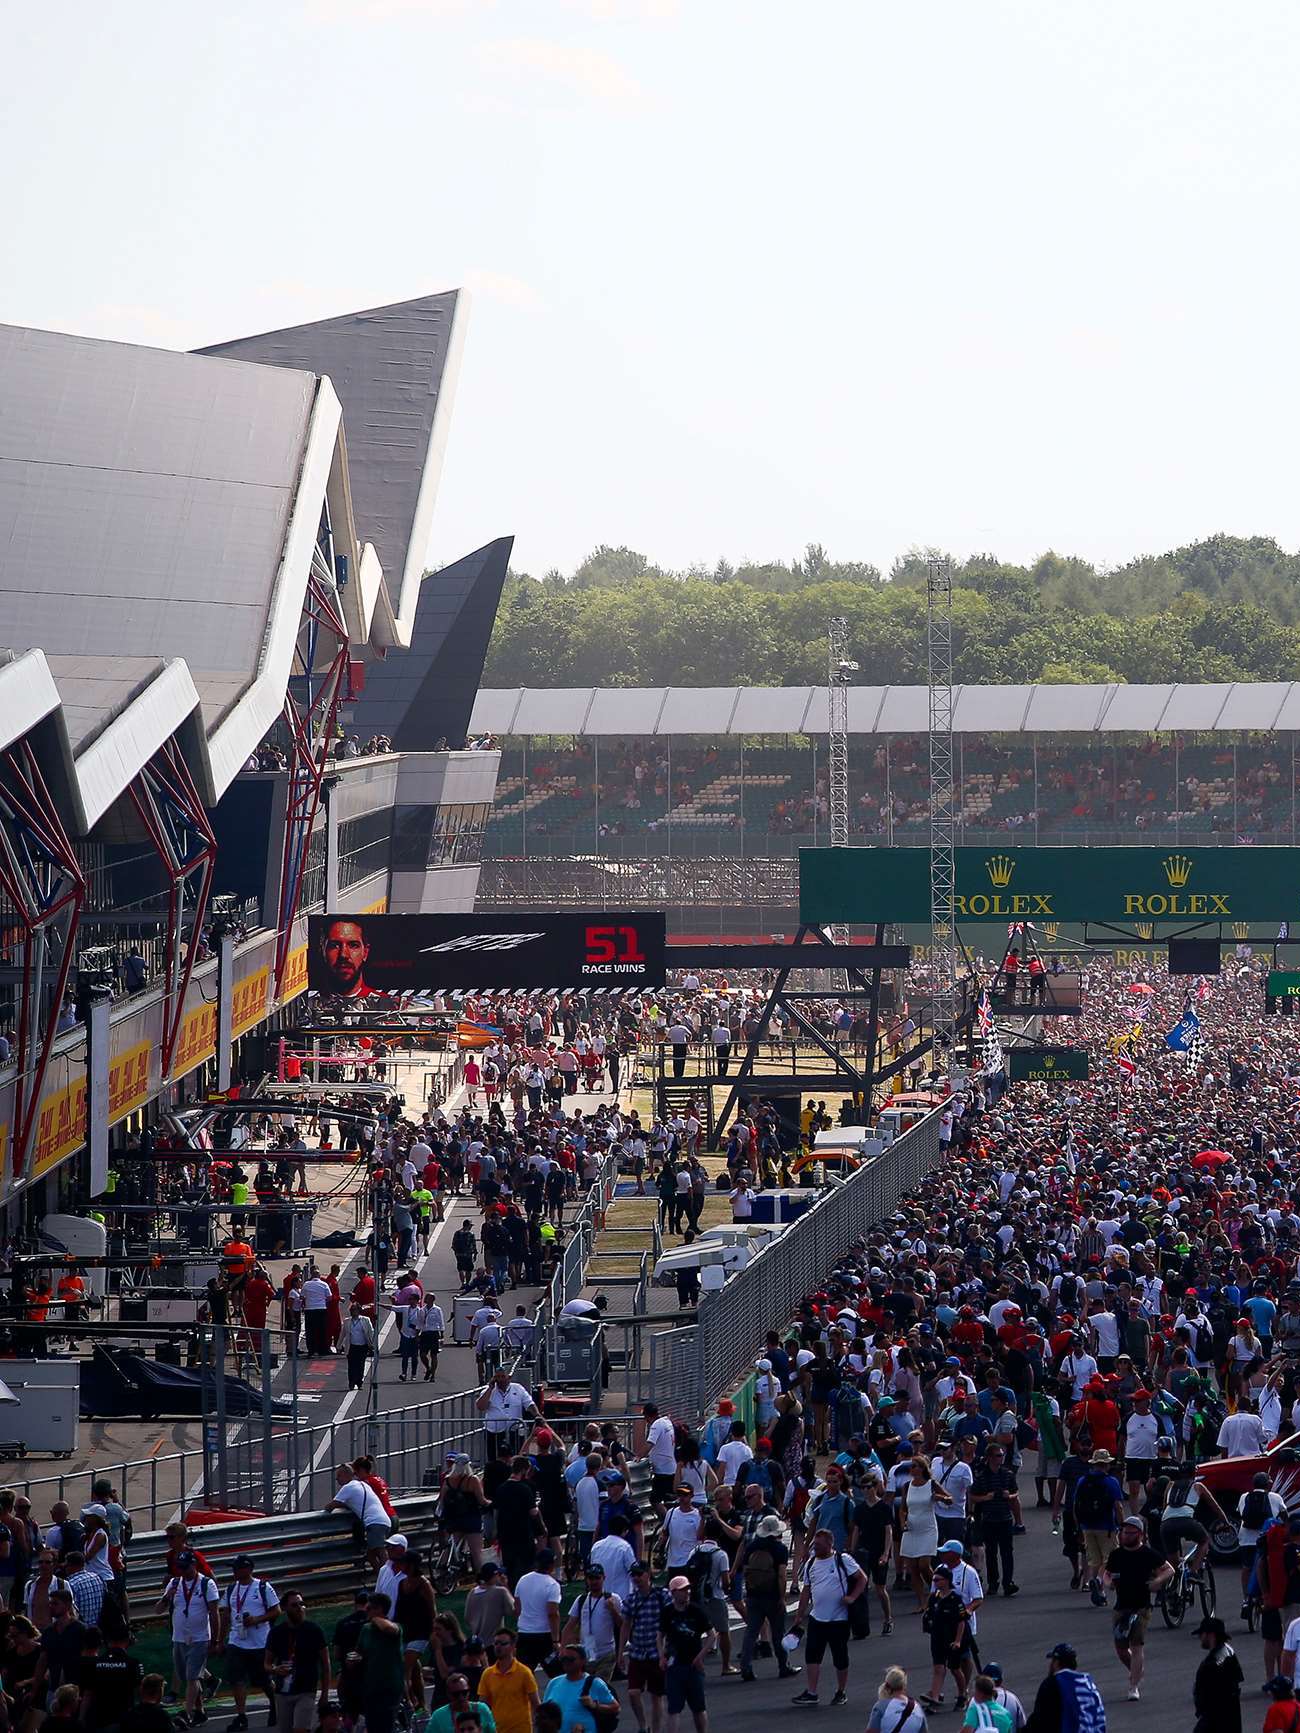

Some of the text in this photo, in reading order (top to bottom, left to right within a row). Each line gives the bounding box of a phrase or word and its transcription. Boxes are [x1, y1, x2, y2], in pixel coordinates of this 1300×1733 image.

[949, 895, 1054, 915] ROLEX
[1124, 894, 1231, 914] ROLEX
[585, 926, 646, 963] 51
[582, 962, 646, 975] RACE WINS
[1029, 1070, 1071, 1080] ROLEX
